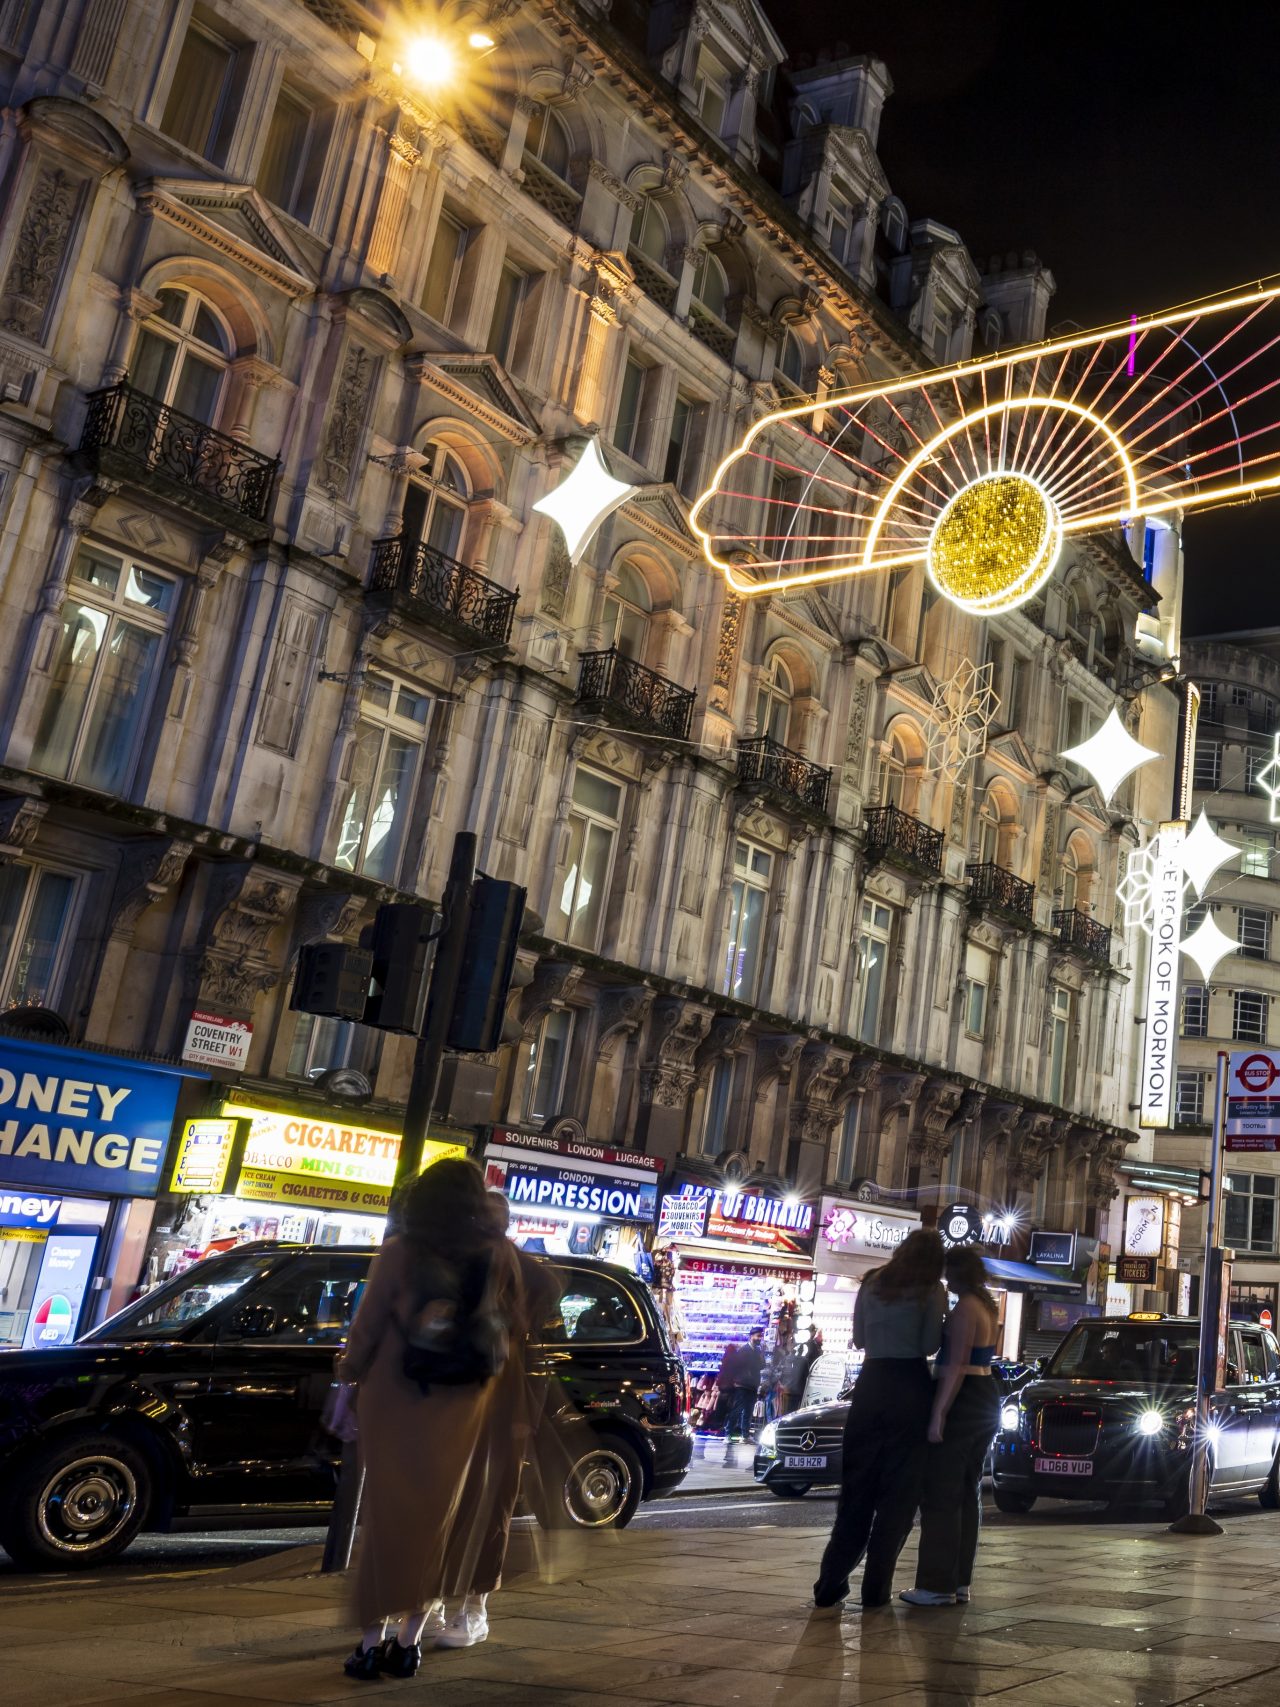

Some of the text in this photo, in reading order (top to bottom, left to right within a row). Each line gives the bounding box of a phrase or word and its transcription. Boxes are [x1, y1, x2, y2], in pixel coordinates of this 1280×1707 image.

[1156, 961, 1172, 992] OF
[194, 1025, 242, 1044] COVENTRY
[191, 1037, 243, 1057] STREET W1
[1148, 1000, 1169, 1107] MORMON
[175, 1124, 195, 1187] OPEN
[213, 1124, 233, 1187] TOBACCO
[505, 1132, 655, 1168] SOUVENIRS LONDON LUGGAGE
[300, 1157, 340, 1174] MINI
[244, 1171, 276, 1182] ICE CREAM
[558, 1170, 595, 1185] LONDON
[282, 1182, 347, 1202] CIGARETTES
[350, 1191, 359, 1203] &
[508, 1175, 641, 1216] IMPRESSION
[860, 1191, 871, 1201] 33
[0, 1196, 61, 1222] ney
[670, 1202, 698, 1210] TOBACCO
[666, 1212, 700, 1220] SOUVENIRS
[671, 1221, 693, 1230] MOBILE
[708, 1223, 724, 1232] pecial
[881, 1243, 892, 1251] Repair
[48, 1258, 76, 1270] Money
[693, 1262, 724, 1272] GIFTS
[743, 1266, 801, 1279] SOUVENIRS
[1124, 1269, 1146, 1278] TICKETS
[39, 1328, 58, 1341] AED
[806, 1457, 822, 1467] HZR
[1041, 1459, 1092, 1473] LD68 VUP
